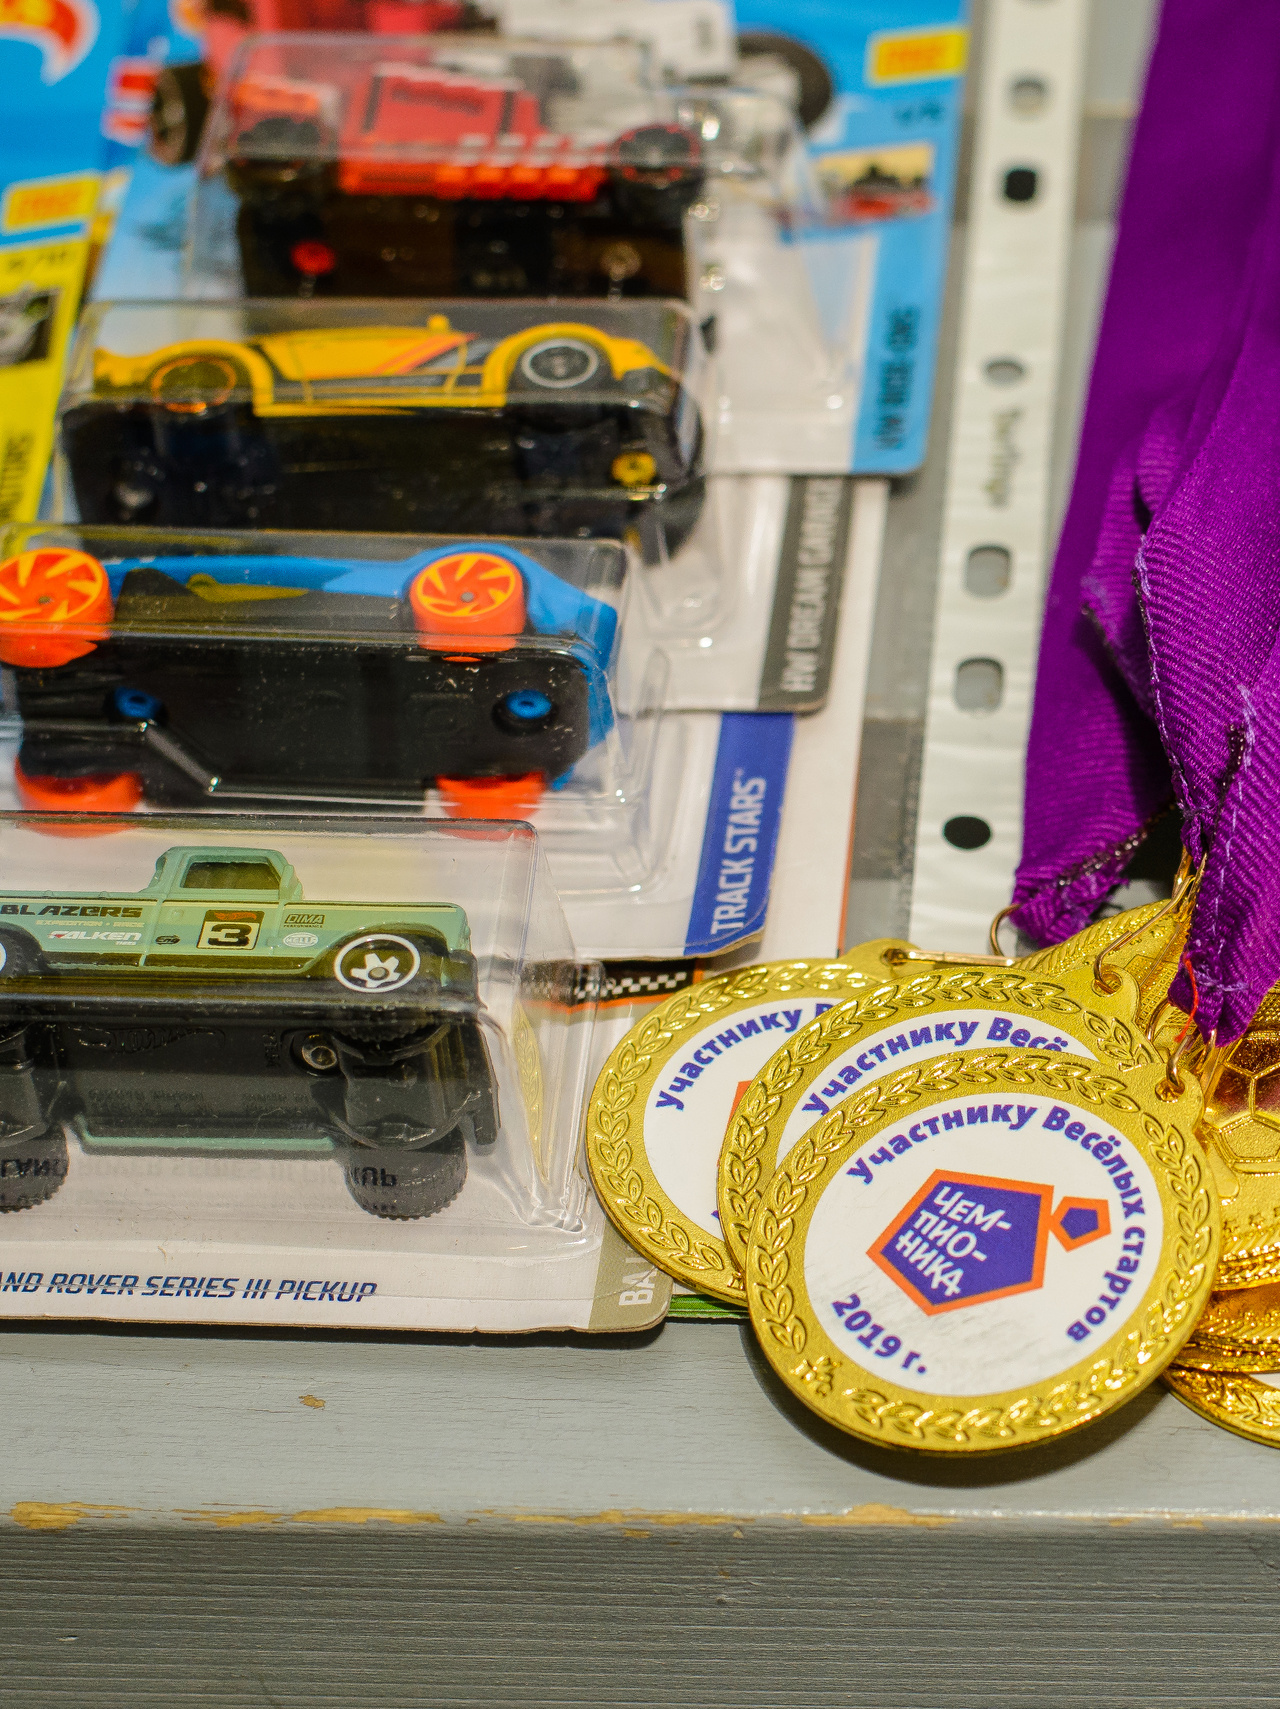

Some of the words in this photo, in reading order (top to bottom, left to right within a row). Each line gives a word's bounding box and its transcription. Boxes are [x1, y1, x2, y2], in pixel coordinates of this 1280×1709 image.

[725, 776, 767, 857] STARS
[0, 904, 144, 918] BLAZERS
[284, 913, 326, 924] DIMA
[711, 858, 752, 935] TRACK
[47, 930, 142, 941] FALKEN
[208, 923, 252, 946] 3
[655, 1008, 803, 1111] Участнику
[801, 1020, 979, 1117] Участнику
[845, 1103, 1037, 1185] Участнику
[1042, 1105, 1146, 1219] Весёлых
[912, 1209, 988, 1262] ПИО-
[933, 1186, 1012, 1232] ЧЕМ-
[0, 1271, 44, 1293] ND
[46, 1273, 140, 1297] ROVER
[141, 1276, 240, 1299] SERIES
[242, 1278, 271, 1300] III
[274, 1279, 378, 1303] PICKUP
[895, 1229, 965, 1297] НИКА
[1066, 1226, 1146, 1342] стартов
[832, 1293, 902, 1359] 2019
[901, 1350, 928, 1375] г.
